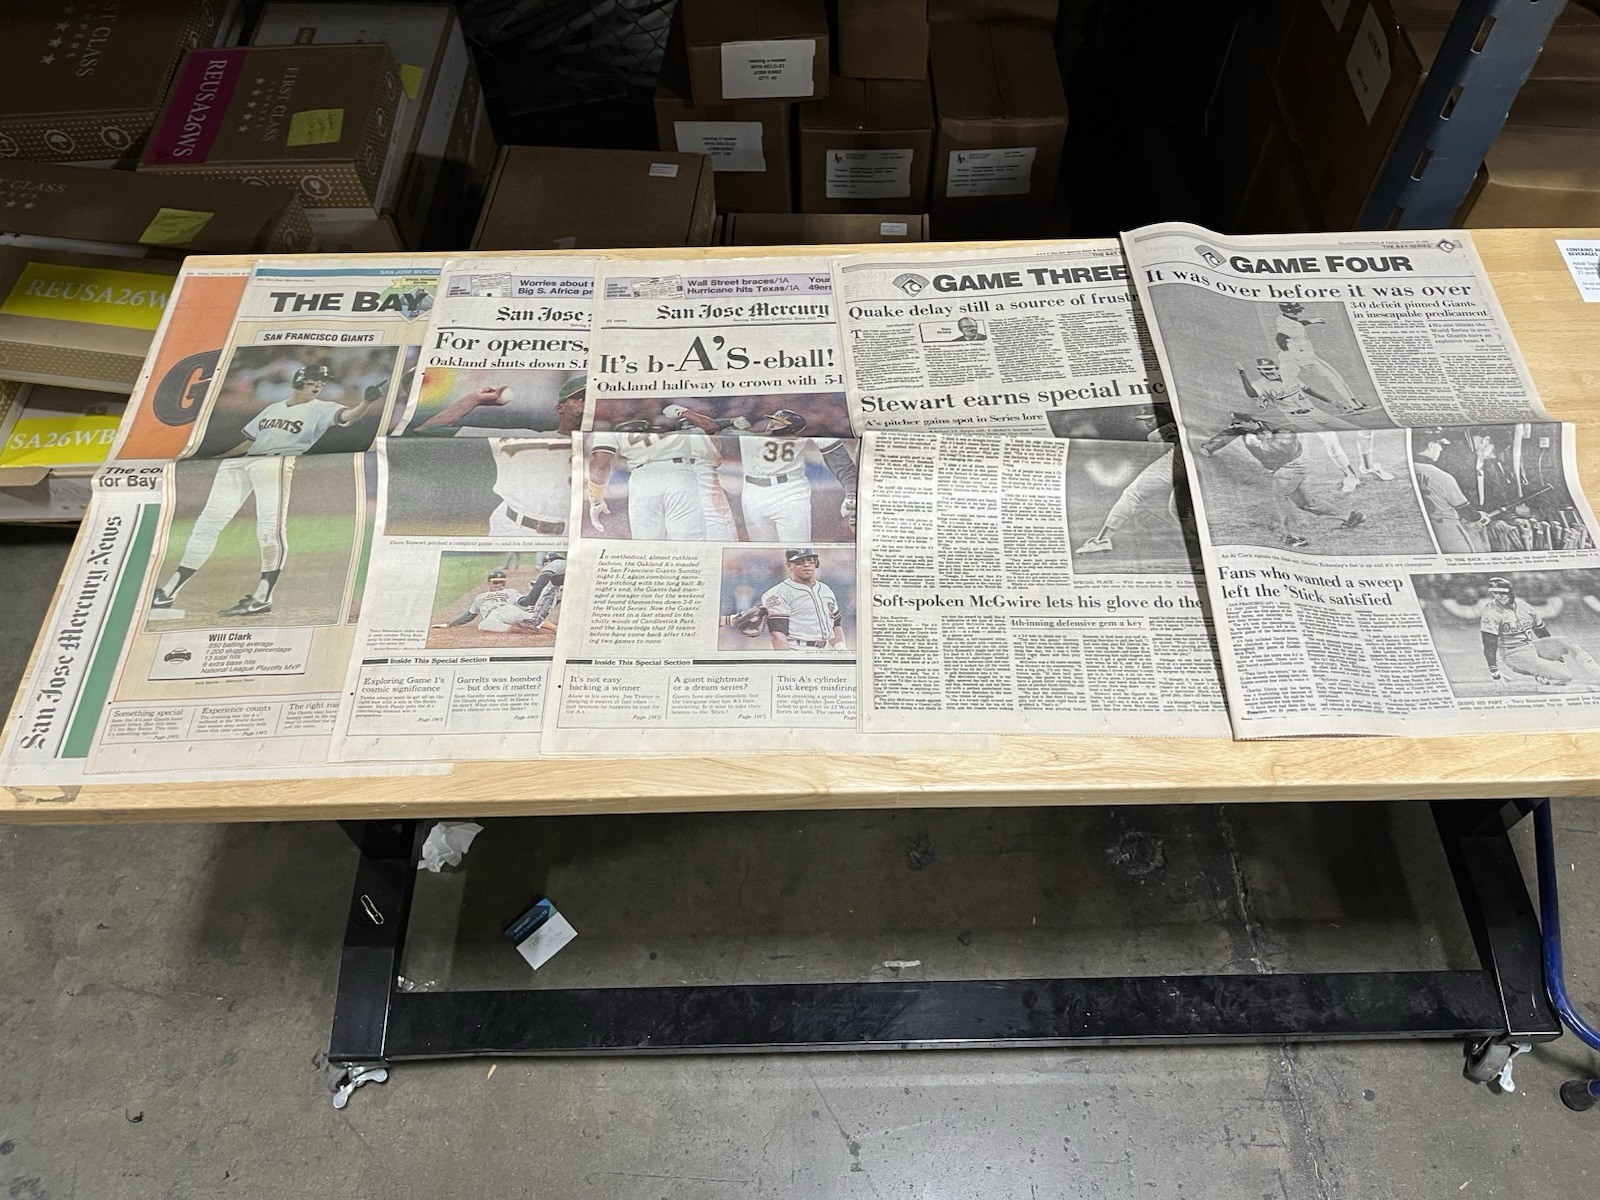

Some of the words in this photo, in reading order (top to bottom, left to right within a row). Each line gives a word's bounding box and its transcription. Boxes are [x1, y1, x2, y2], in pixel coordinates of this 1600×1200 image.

[76, 27, 111, 77] CLASS
[278, 67, 299, 101] FIRST
[172, 59, 228, 157] REUSA26WS
[262, 105, 287, 141] CLASS
[10, 180, 67, 193] CLASS
[1230, 256, 1320, 273] GAME
[1325, 256, 1414, 272] FOUR
[742, 277, 789, 285] braces/1A
[933, 272, 1023, 293] GAME
[1027, 265, 1131, 286] THREE
[1144, 270, 1164, 283] It
[1172, 271, 1210, 286] was
[1217, 283, 1261, 297] over
[1268, 285, 1340, 298] before
[1348, 284, 1365, 297] it
[1373, 285, 1414, 296] was
[1422, 285, 1471, 296] over
[687, 286, 733, 294] Hurricane
[757, 284, 800, 292] Texas/1A
[270, 292, 344, 312] THE
[351, 291, 425, 312] BAY
[849, 306, 904, 320] Quake
[909, 303, 952, 318] delay
[959, 300, 989, 313] still
[996, 303, 1004, 311] a
[1010, 298, 1065, 310] source
[1070, 294, 1086, 305] of
[1404, 300, 1439, 310] pinned
[495, 307, 534, 321] San
[538, 306, 584, 322] Jose
[656, 304, 694, 320] San
[699, 303, 744, 319] Jose
[748, 302, 829, 318] Mercury
[1366, 310, 1422, 320] inescapable
[1425, 309, 1488, 319] predicament
[263, 333, 283, 342] SAN
[285, 332, 338, 342] FRANCISCO
[340, 333, 375, 342] GIANTS
[433, 332, 480, 350] For
[487, 338, 589, 356] openers,
[430, 356, 487, 368] Oakland
[490, 358, 525, 368] shuts
[529, 358, 565, 368] down
[598, 355, 638, 374] It's
[597, 381, 657, 392] Oakland
[662, 379, 717, 393] halfway
[721, 380, 733, 389] to
[739, 380, 782, 389] crown
[787, 375, 818, 385] with
[861, 393, 956, 413] Stewart
[964, 392, 1030, 408] earns
[1038, 380, 1120, 407] special
[258, 418, 303, 434] GIANTS
[884, 419, 921, 427] pitcher
[924, 418, 950, 426] gains
[952, 417, 973, 425] spot
[763, 441, 796, 462] 36
[105, 466, 139, 474] The
[99, 475, 120, 487] for
[128, 475, 156, 489] Bay
[87, 515, 122, 565] News
[1218, 566, 1256, 580] Fans
[1259, 566, 1290, 580] who
[1293, 573, 1341, 588] wanted
[1346, 578, 1353, 588] a
[1359, 578, 1403, 592] sweep
[873, 594, 964, 610] Soft-spoken
[969, 594, 1041, 608] McGwire
[1046, 595, 1073, 608] lets
[1077, 595, 1101, 608] his
[1106, 594, 1149, 612] glove
[1153, 594, 1174, 608] do
[1178, 594, 1204, 608] the
[1221, 585, 1249, 599] left
[1255, 584, 1280, 598] the
[1284, 584, 1324, 603] 'Stick
[1329, 593, 1393, 606] satisfied
[57, 568, 108, 651] Mercury
[1010, 619, 1055, 629] 4th-inning
[1056, 619, 1097, 627] defensive
[1099, 621, 1115, 629] gem
[1128, 619, 1143, 628] key
[37, 654, 74, 704] Jose
[363, 677, 404, 686] Exploring
[569, 684, 602, 692] backing
[795, 684, 818, 692] keeps
[821, 684, 857, 692] misfiring
[814, 676, 847, 684] cylinder
[201, 707, 244, 715] Experience
[20, 707, 56, 749] San
